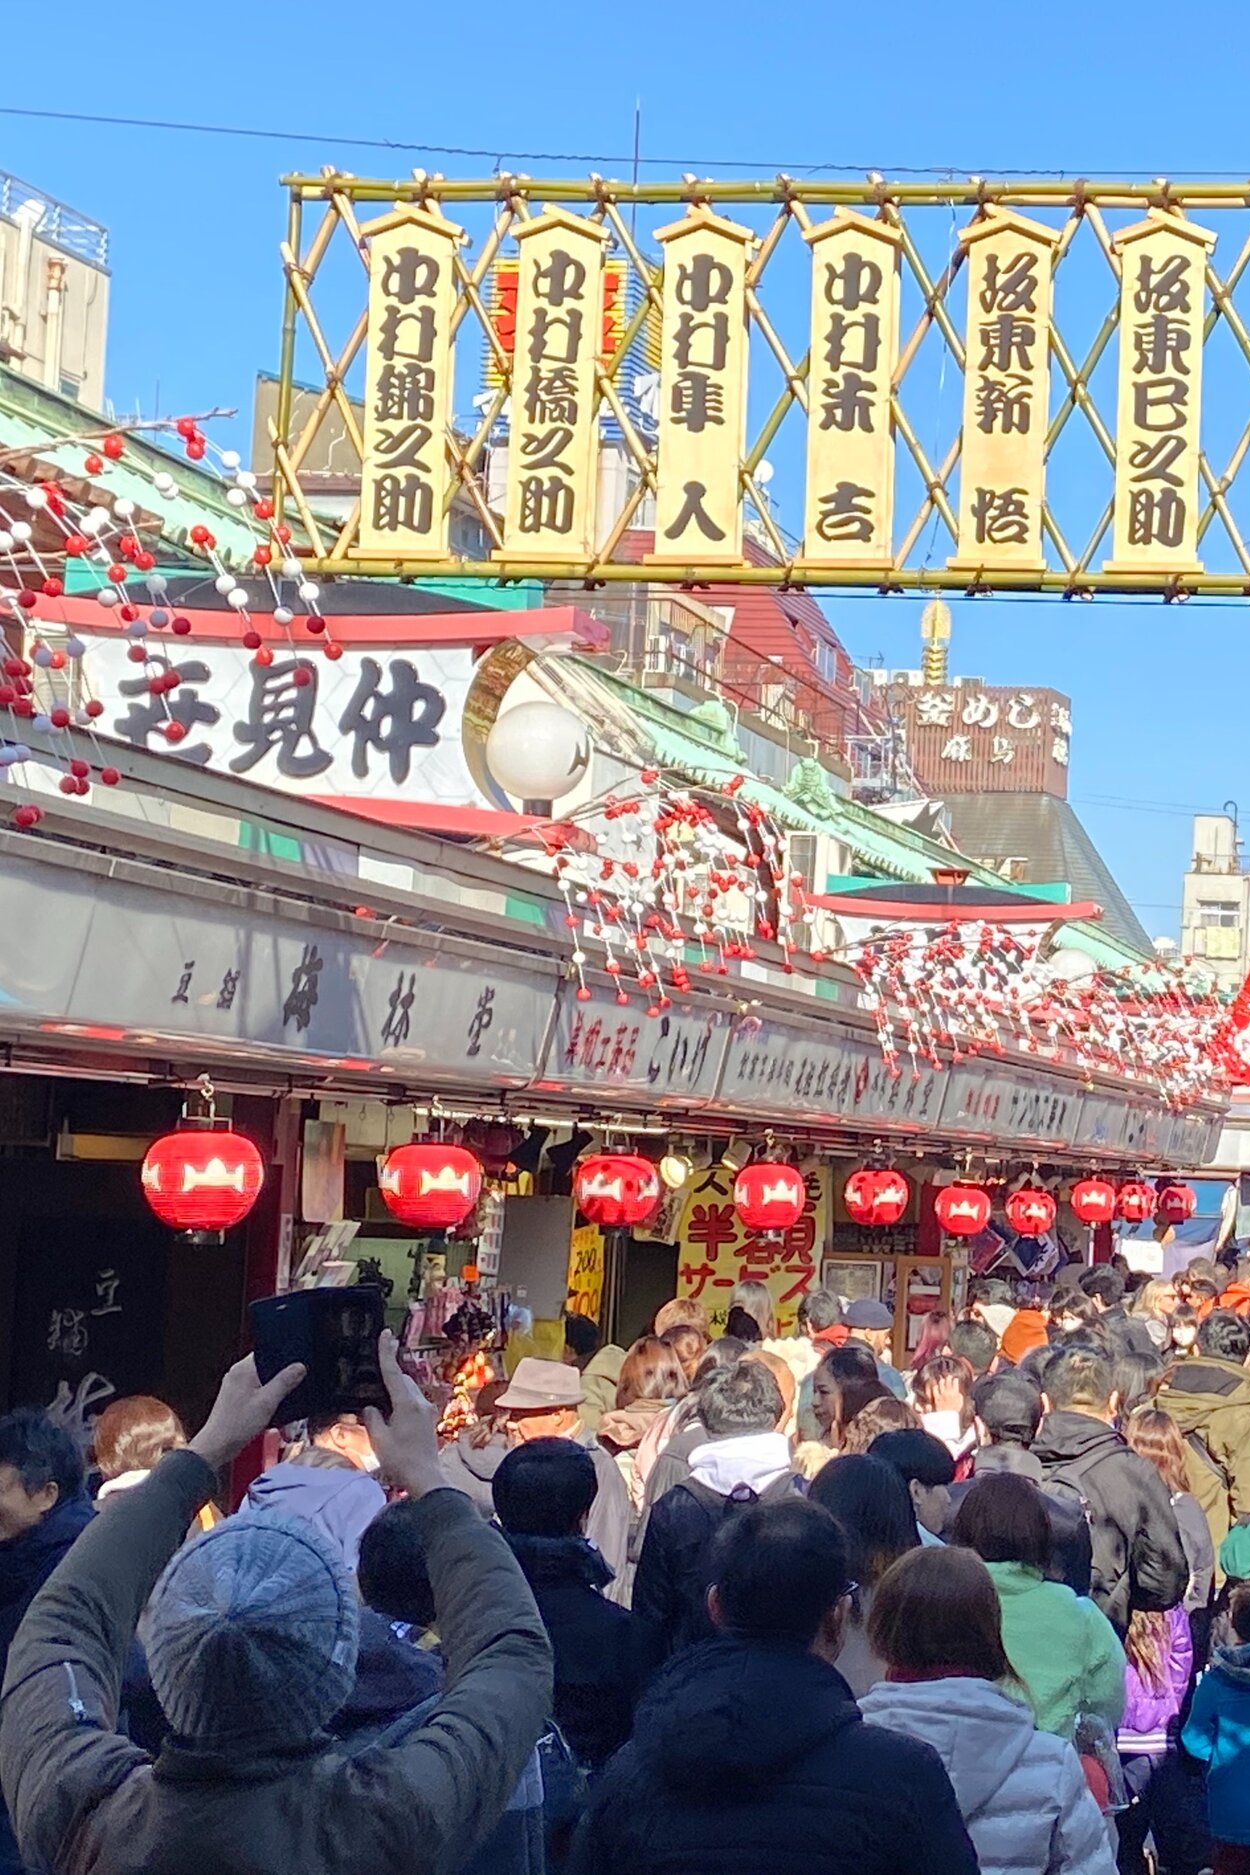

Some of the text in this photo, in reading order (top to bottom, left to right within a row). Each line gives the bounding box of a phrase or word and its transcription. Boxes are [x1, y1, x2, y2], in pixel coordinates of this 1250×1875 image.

[916, 691, 1040, 729] 釜めし
[679, 1262, 817, 1305] サービス
